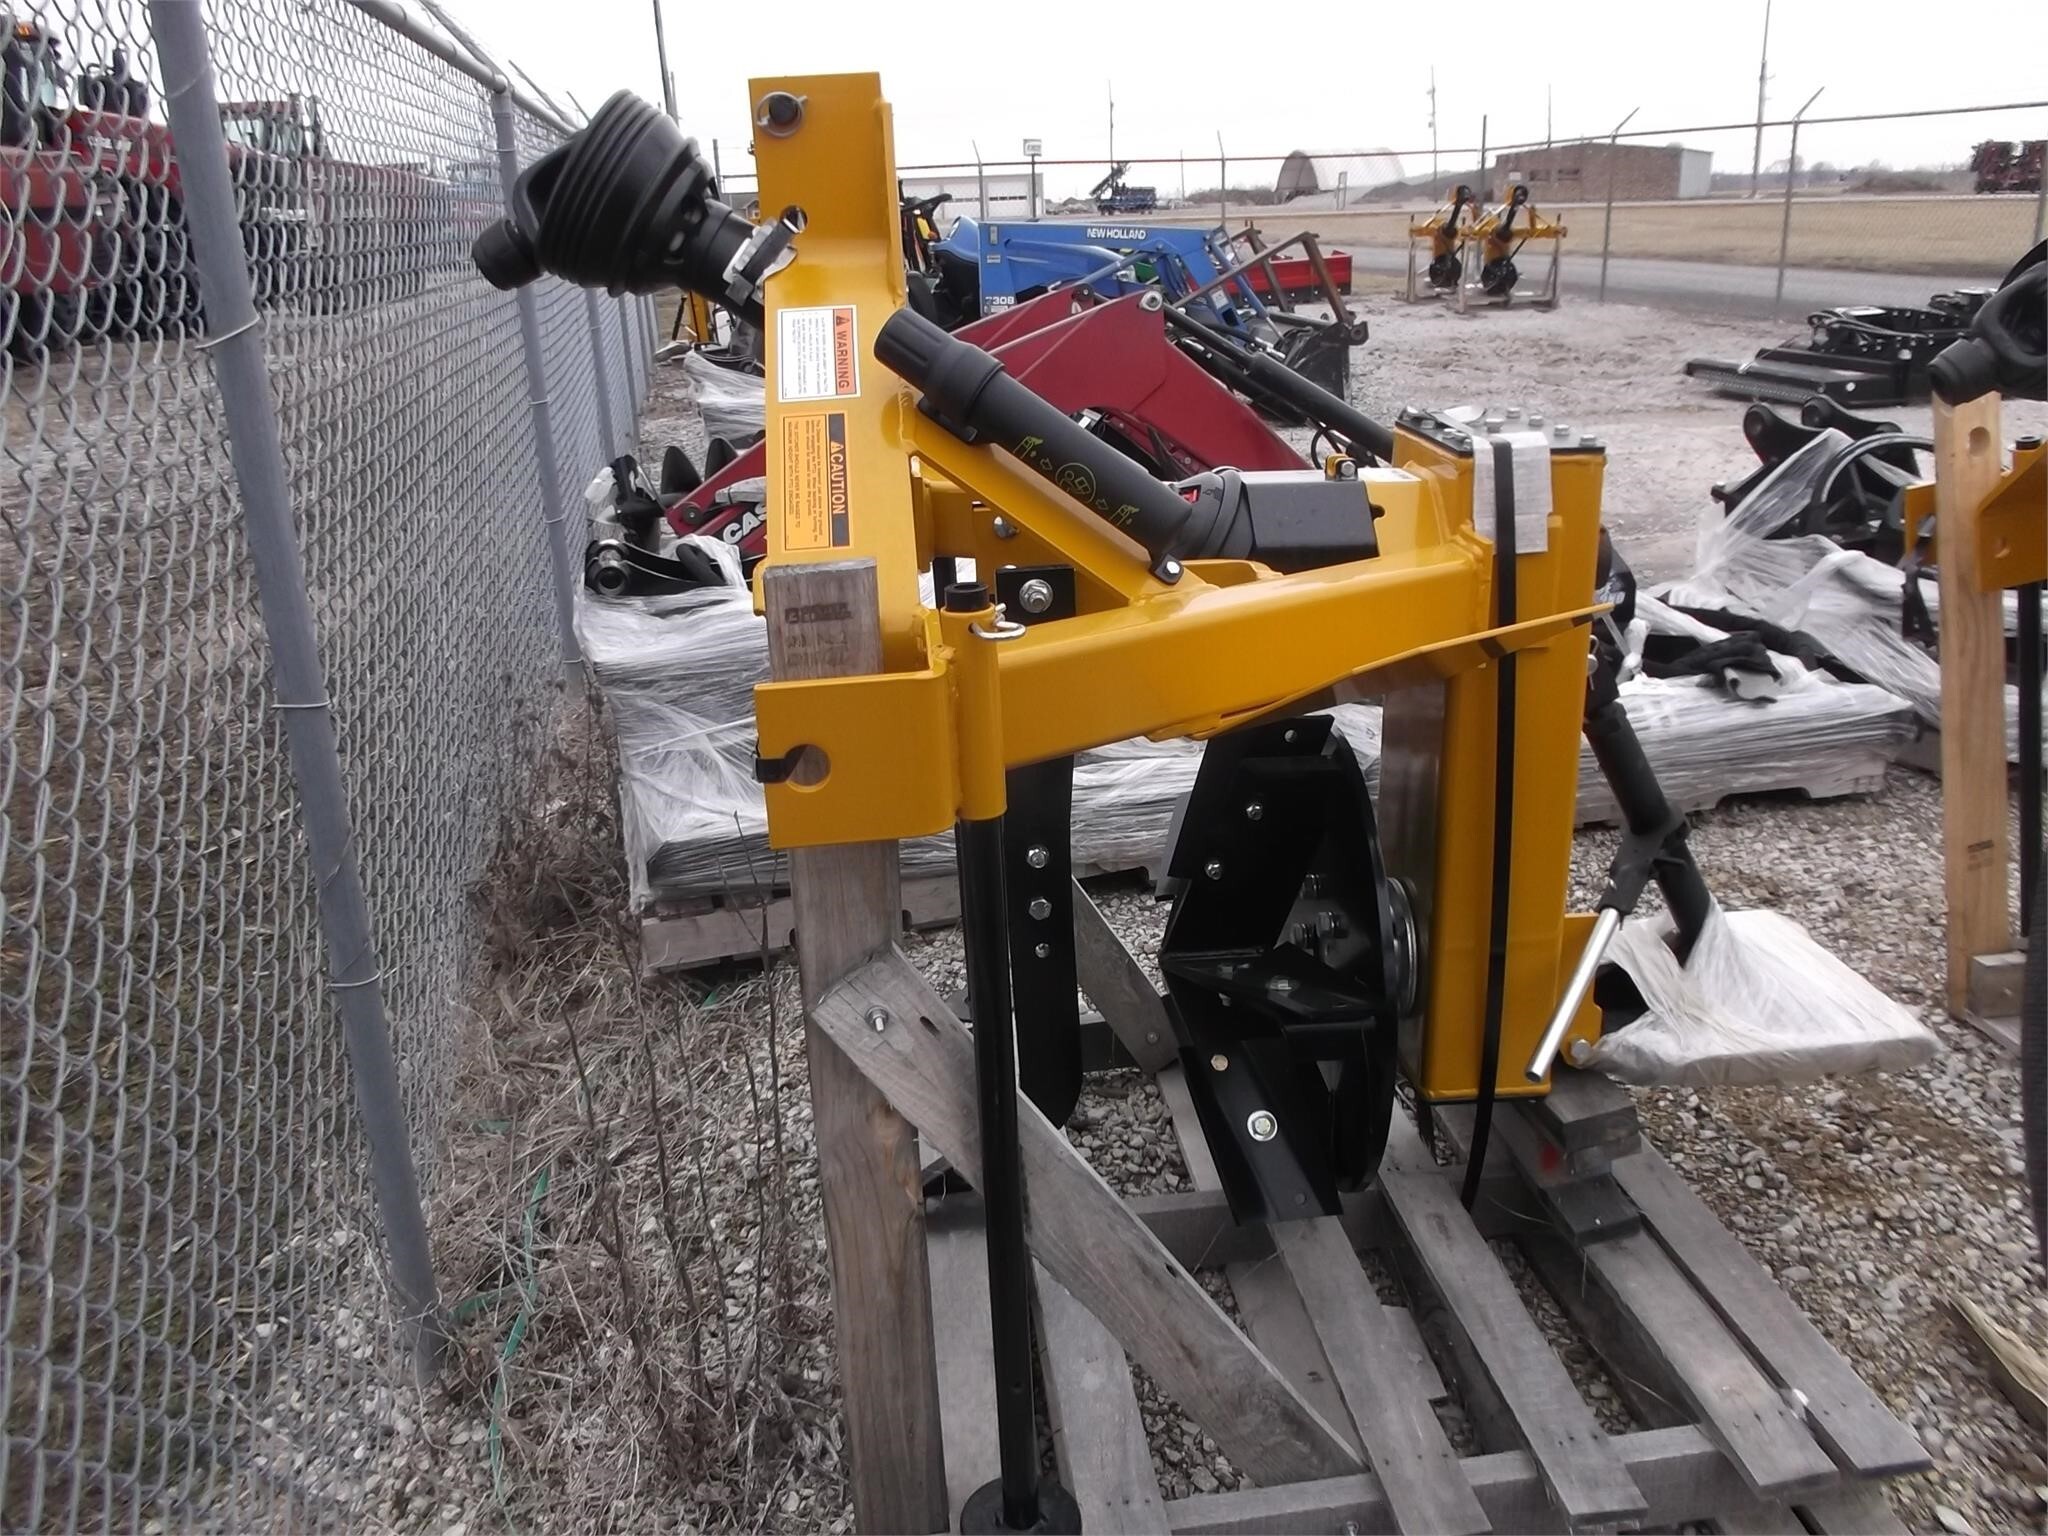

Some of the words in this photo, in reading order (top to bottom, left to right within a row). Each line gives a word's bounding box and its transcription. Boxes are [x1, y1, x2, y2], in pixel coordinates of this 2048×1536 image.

[1087, 228, 1106, 239] NEW
[1106, 228, 1147, 240] HOLLAND
[836, 330, 850, 389] WARNING
[830, 455, 846, 515] CAUTION
